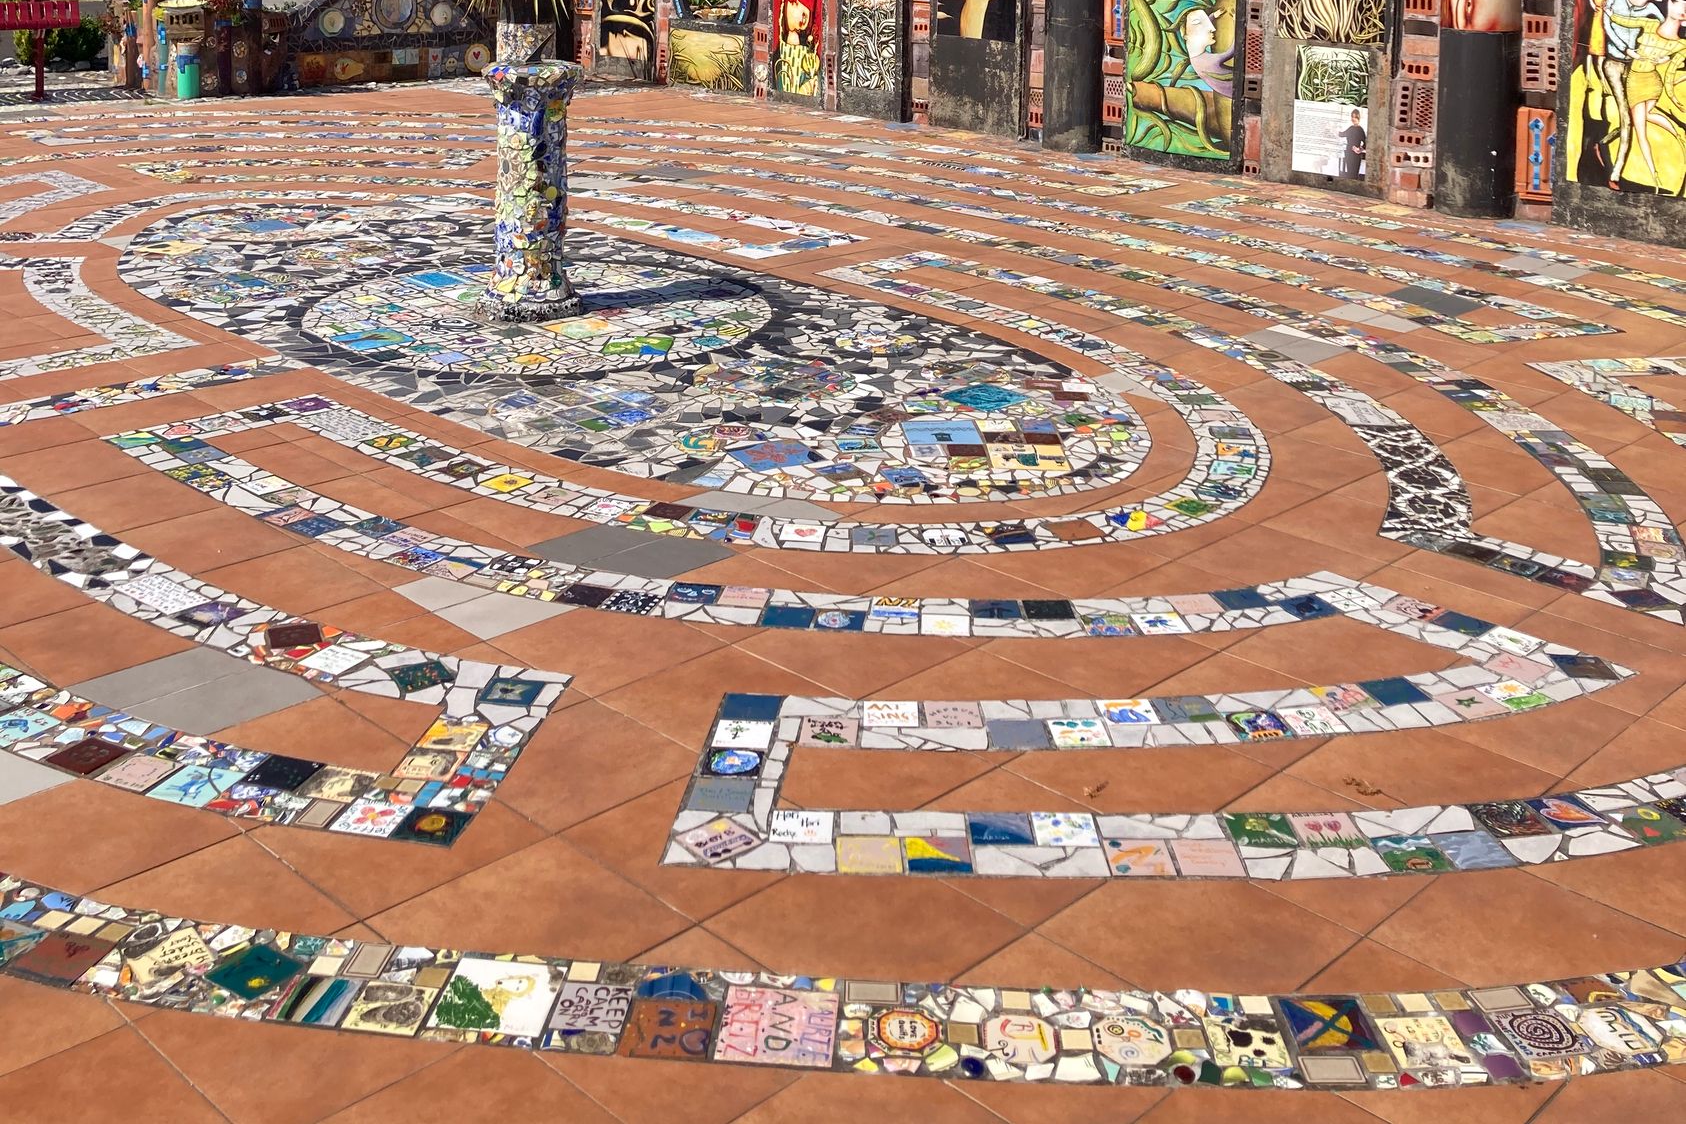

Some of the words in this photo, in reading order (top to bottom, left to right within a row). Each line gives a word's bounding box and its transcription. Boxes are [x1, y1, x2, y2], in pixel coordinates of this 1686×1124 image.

[559, 998, 576, 1017] ON
[565, 987, 585, 1027] CARRY
[582, 999, 593, 1018] AND
[593, 986, 609, 1027] CALM
[608, 987, 630, 1030] KEEP
[763, 990, 798, 1052] AND
[908, 1020, 918, 1040] LOVE
